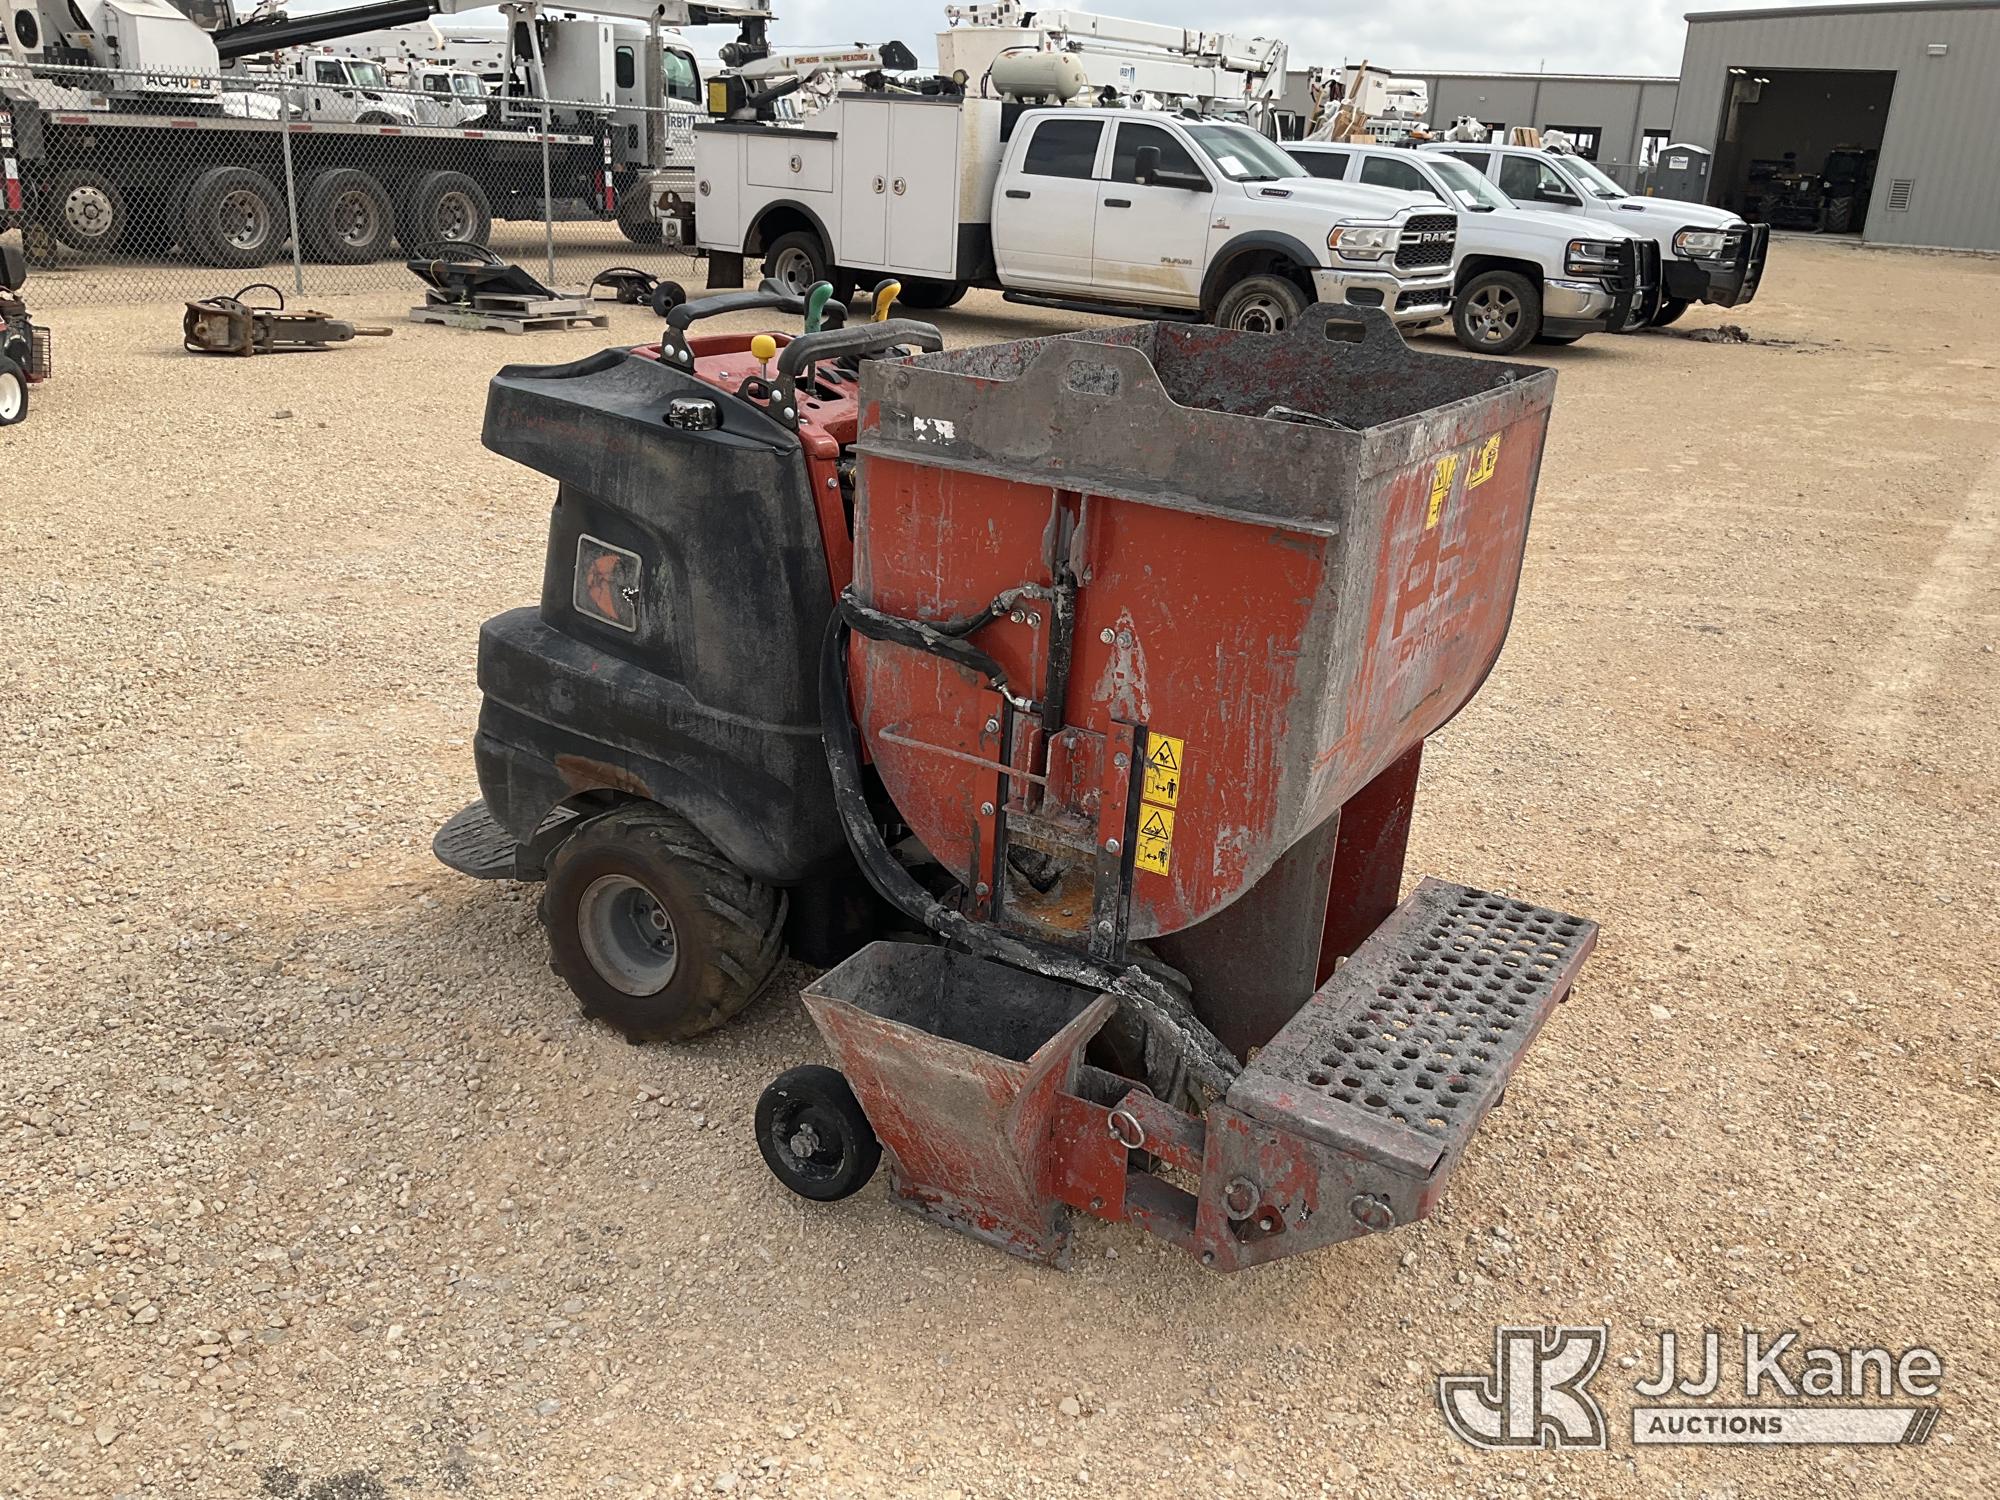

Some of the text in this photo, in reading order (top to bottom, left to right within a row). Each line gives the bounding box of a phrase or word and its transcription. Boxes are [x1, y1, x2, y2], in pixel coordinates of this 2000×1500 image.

[842, 53, 868, 62] READING
[146, 70, 189, 88] AC40
[1422, 232, 1449, 242] RAM
